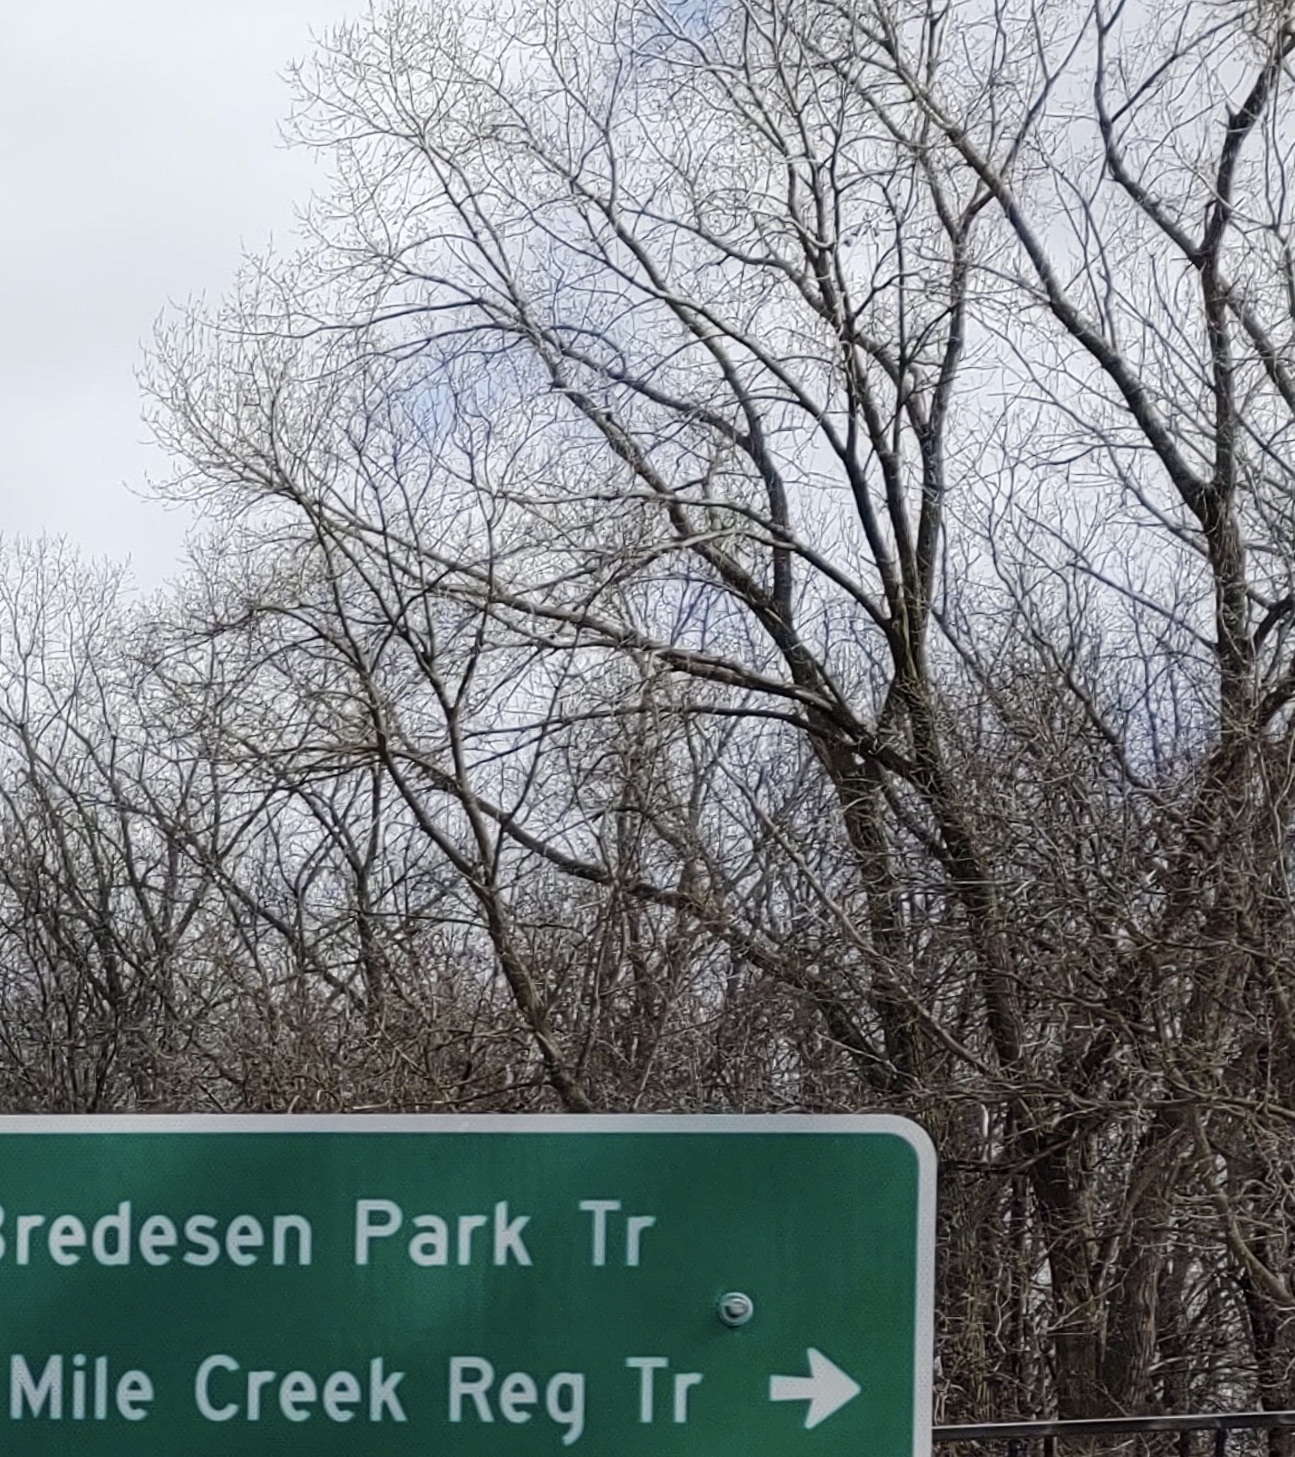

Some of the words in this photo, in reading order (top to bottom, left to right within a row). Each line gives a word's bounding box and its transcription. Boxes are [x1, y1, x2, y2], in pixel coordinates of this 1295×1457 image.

[354, 1198, 532, 1268] Park
[579, 1199, 656, 1268] Tr
[9, 1353, 155, 1422] Mile
[195, 1354, 408, 1424] Creek
[448, 1357, 585, 1445] Reg
[626, 1356, 703, 1425] Tr
